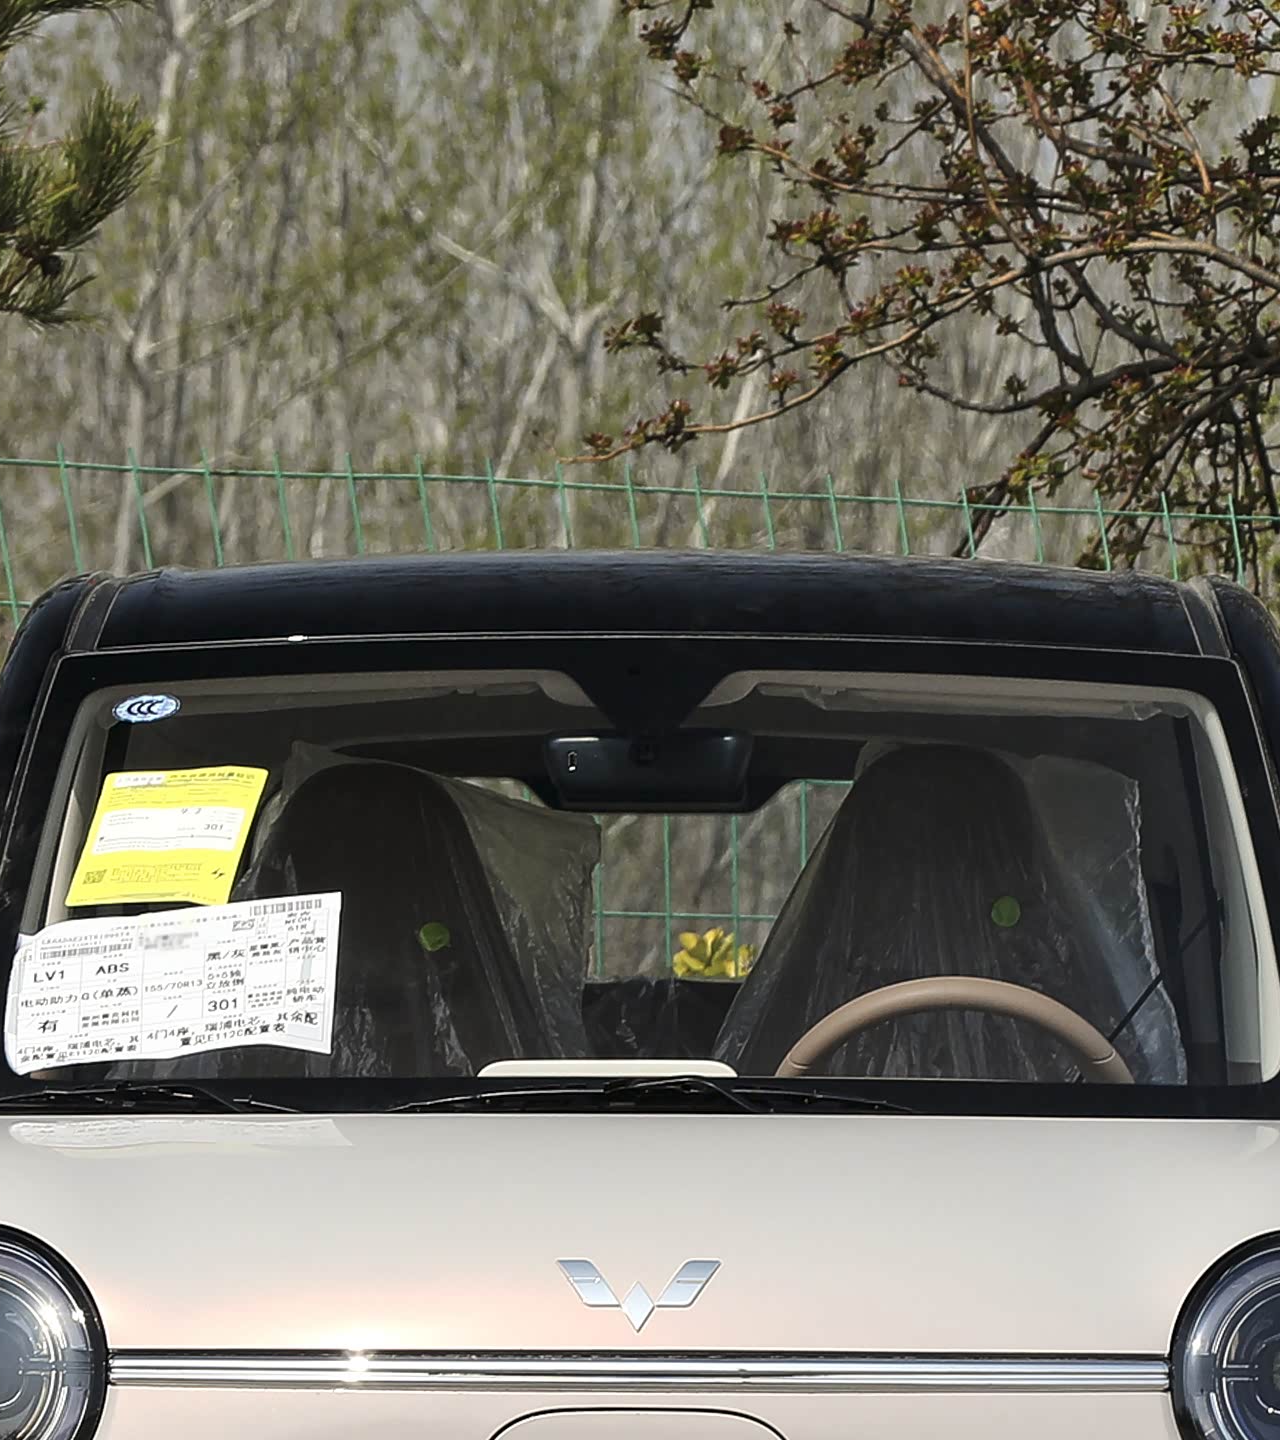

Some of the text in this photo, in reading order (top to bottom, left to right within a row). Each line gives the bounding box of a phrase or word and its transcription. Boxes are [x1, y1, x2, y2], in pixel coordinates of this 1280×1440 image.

[127, 699, 164, 716] CCC
[33, 969, 65, 983] LV1
[95, 962, 130, 976] ABS
[207, 996, 238, 1013] 301
